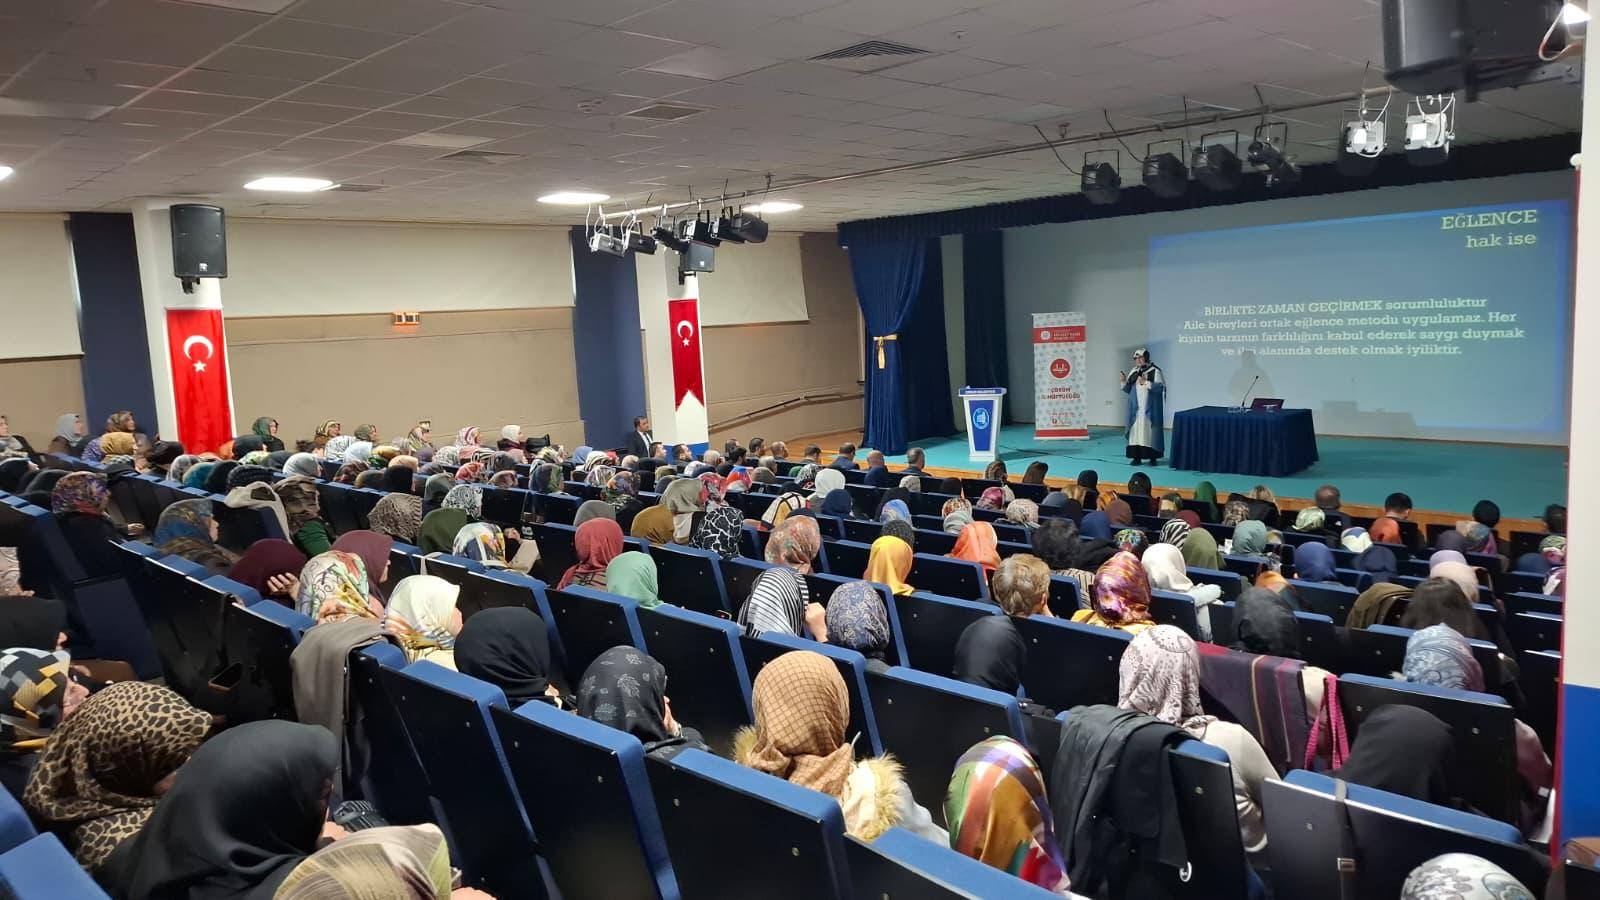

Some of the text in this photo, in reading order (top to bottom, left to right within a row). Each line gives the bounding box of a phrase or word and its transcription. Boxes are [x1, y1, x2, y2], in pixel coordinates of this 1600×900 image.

[1440, 209, 1538, 230] EĞLENCE
[1465, 232, 1537, 248] hak ise
[1258, 303, 1305, 314] ZAMAN
[1308, 300, 1383, 314] GEÇİRMEK
[1385, 298, 1488, 310] sorumluluktur
[1183, 312, 1517, 330] Aile bireyleri ortak eğlence metodu uygulamaz. Her
[1327, 330, 1364, 341] kabul
[1367, 329, 1417, 340] ederek
[1419, 330, 1459, 341] saygı
[1461, 328, 1526, 341] duymak
[1314, 344, 1359, 356] destek
[1361, 344, 1404, 355] olmak
[1407, 343, 1462, 356] iyiliktir.
